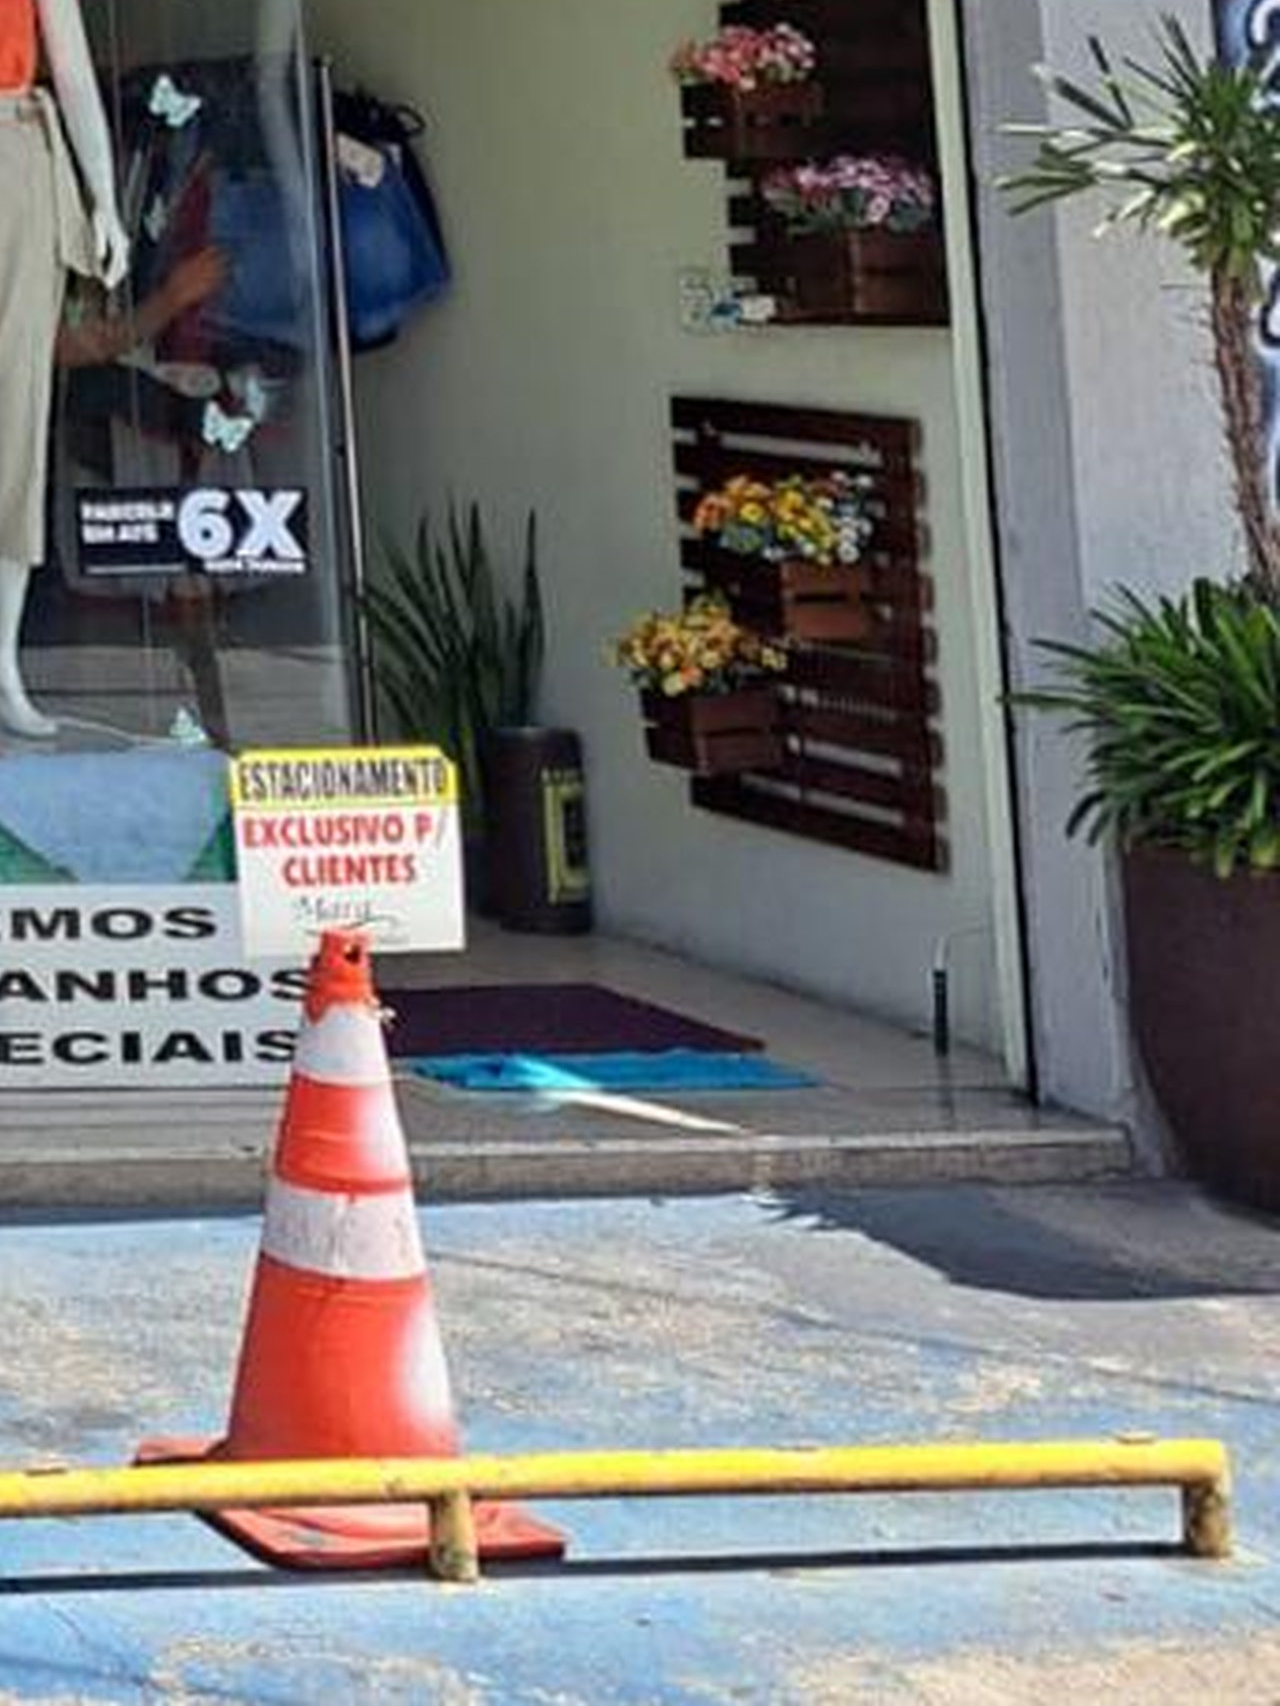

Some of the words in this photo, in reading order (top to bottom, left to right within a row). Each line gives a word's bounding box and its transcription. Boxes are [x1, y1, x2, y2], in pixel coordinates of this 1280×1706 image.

[177, 489, 307, 560] 6X
[242, 813, 406, 849] EXCLUSIVO
[283, 855, 417, 887] CLIENTES
